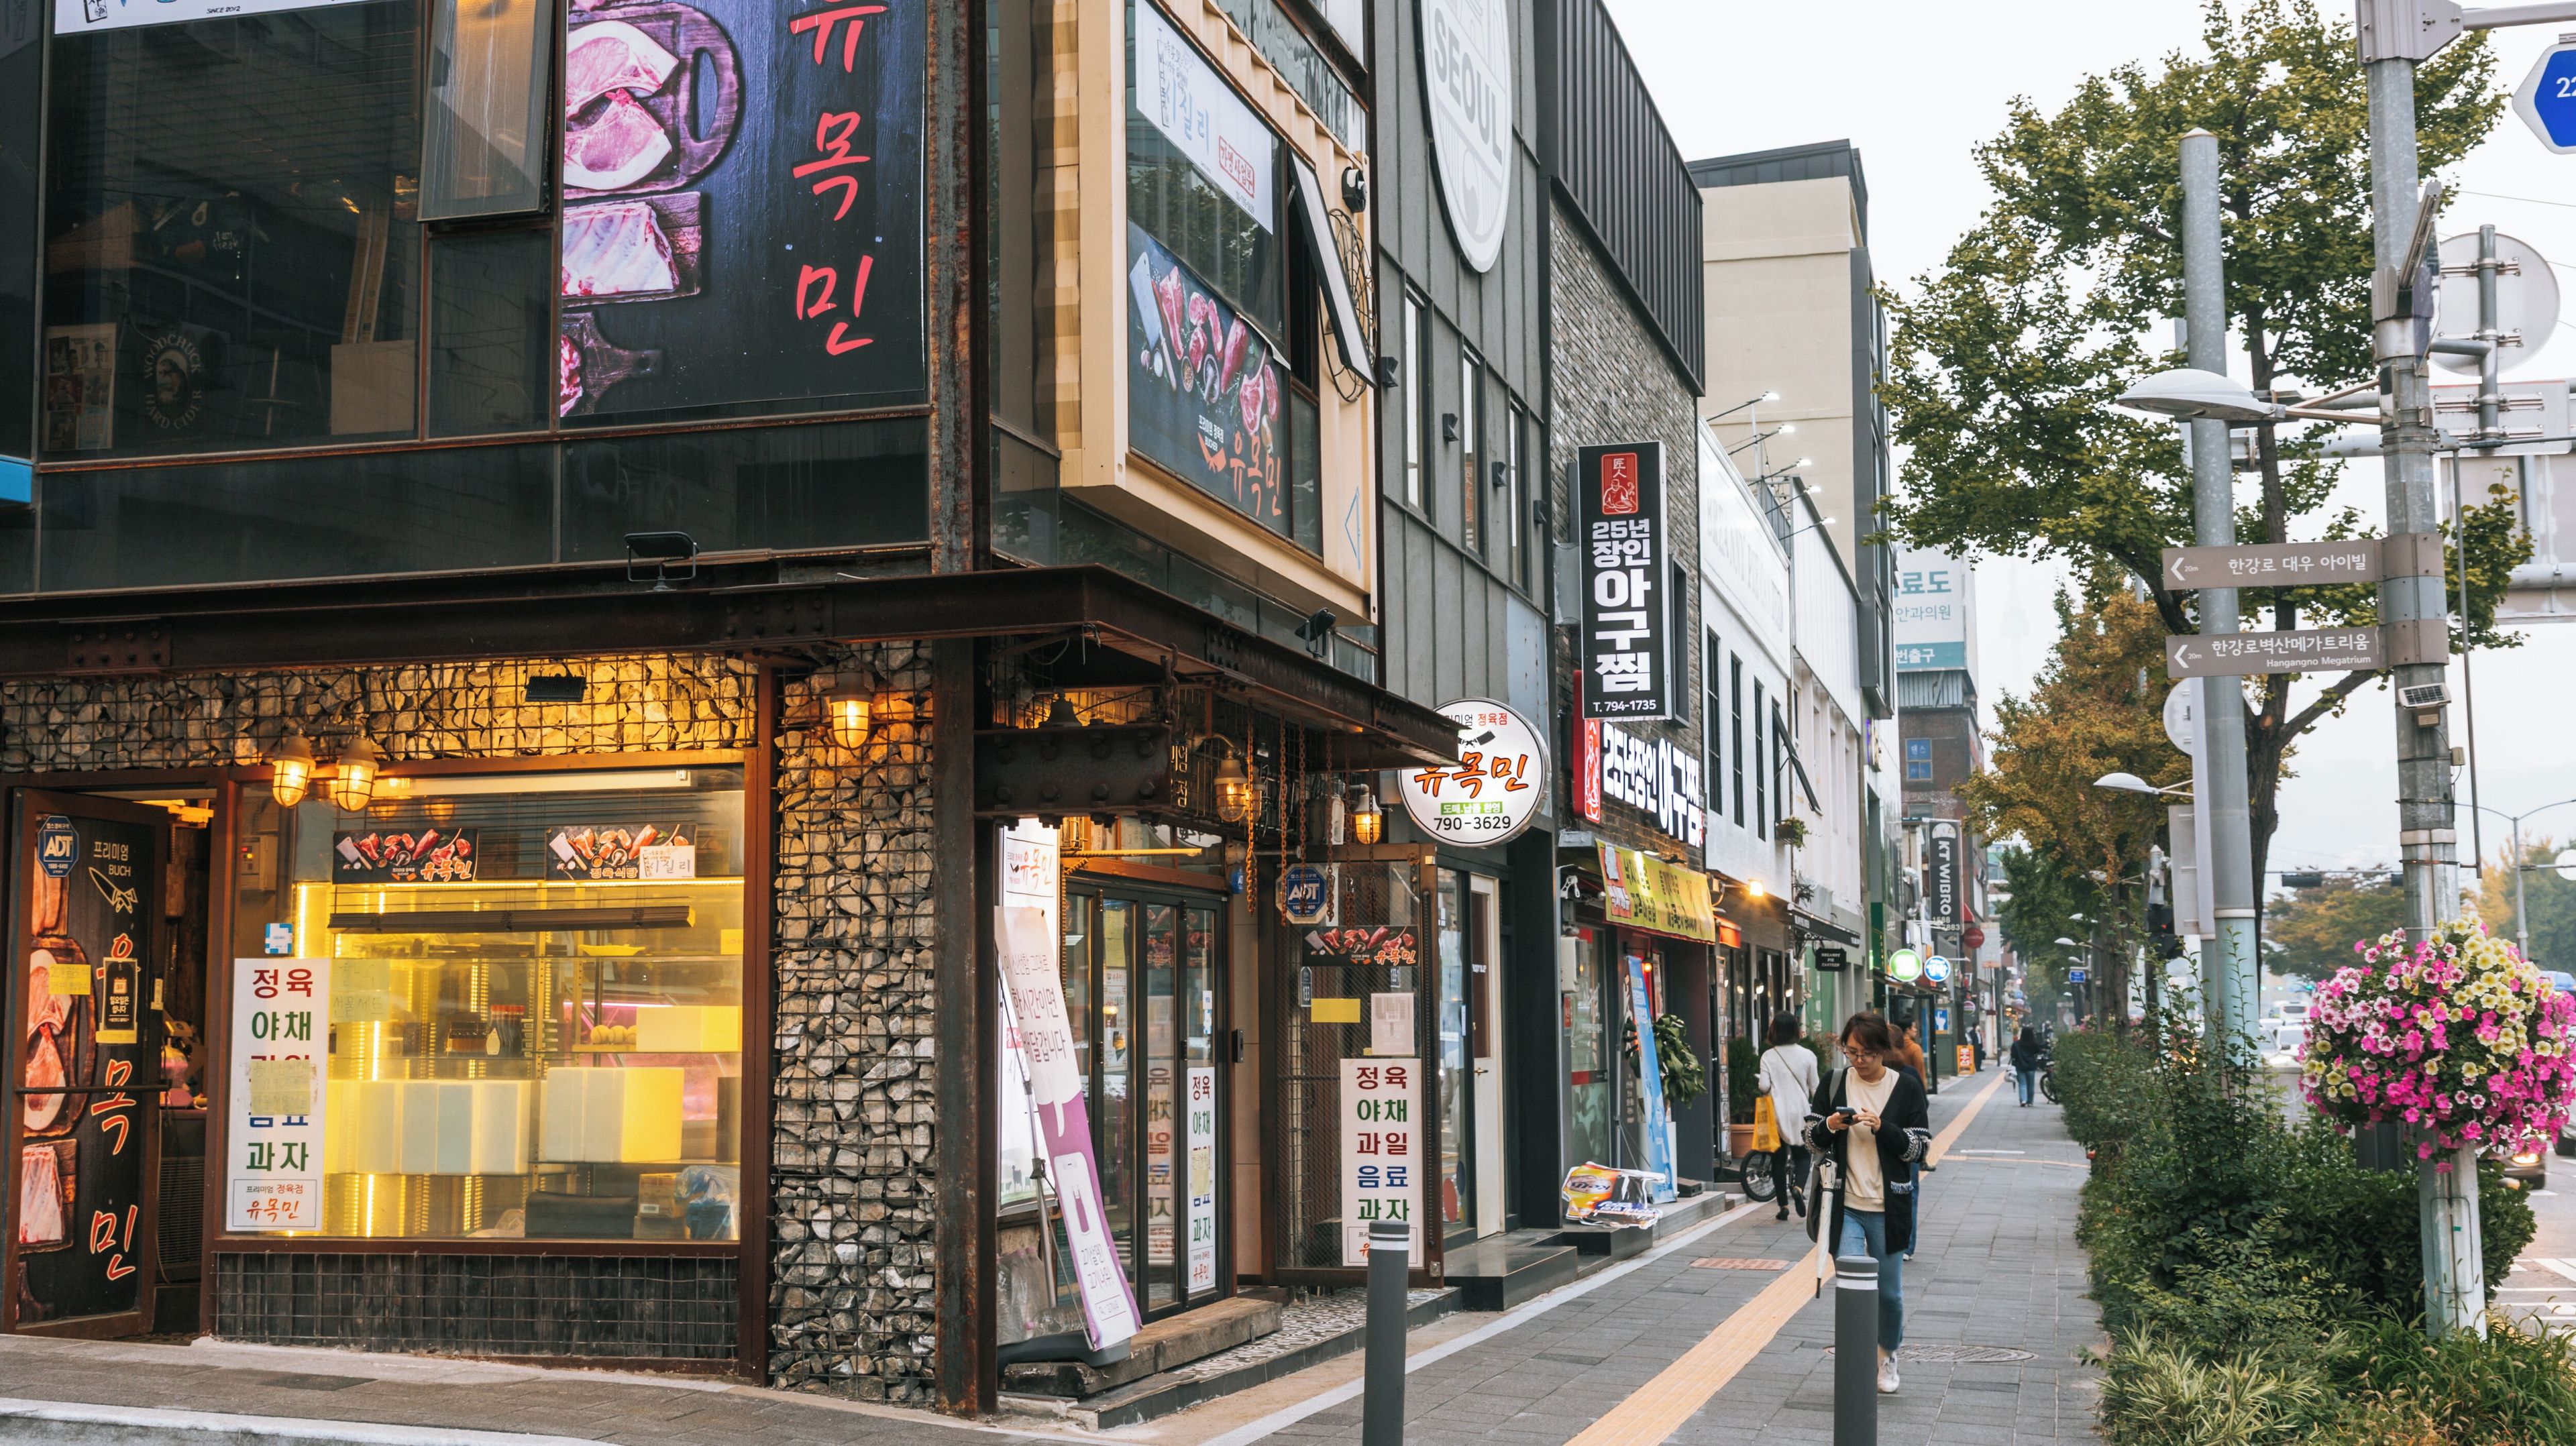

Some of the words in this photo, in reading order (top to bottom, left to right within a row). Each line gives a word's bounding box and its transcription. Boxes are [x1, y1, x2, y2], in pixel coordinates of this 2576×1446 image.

[1434, 7, 1503, 166] SEOUL
[144, 334, 201, 379] WOODCHUCK
[146, 394, 170, 429] HARD
[174, 390, 201, 429] CIDER
[1230, 431, 1282, 516] 유목민
[1613, 458, 1627, 478] 匠人
[1593, 518, 1650, 539] 25년
[1592, 539, 1650, 567] 장인
[2228, 558, 2277, 575] 한강로
[2282, 556, 2314, 572] 대우
[2320, 553, 2366, 571] 아이빌
[1896, 605, 1951, 622] 안과의원
[1594, 568, 1651, 692] 아구찜
[1896, 648, 1935, 663] 번출구
[2212, 634, 2369, 657] 한강로벽산메가트리움
[2267, 659, 2318, 668] Hangangno
[2321, 656, 2371, 666] Megatrium
[1593, 702, 1602, 712] T.
[1605, 699, 1656, 712] 794-1735
[1478, 713, 1507, 726] 정육점
[1414, 752, 1529, 799] 유목민
[1434, 816, 1511, 830] 790-3629
[44, 836, 73, 856] ADT
[93, 841, 129, 861] 프리미엄
[1938, 840, 1950, 860] KT
[109, 864, 131, 877] BUCH
[421, 859, 472, 882] 유목민
[590, 867, 638, 879] 정육식당
[1020, 848, 1052, 889] 유목민
[1288, 883, 1320, 901] ADT
[1939, 863, 1951, 915] WIBRO
[1374, 948, 1416, 965] 유목민
[253, 968, 313, 998] 정육
[1012, 987, 1059, 1019] 한시간이면
[252, 1011, 312, 1041] 야채
[1193, 1076, 1210, 1101] 정육
[1356, 1067, 1407, 1089] 정육
[1357, 1099, 1407, 1122] 야채
[1193, 1111, 1210, 1135] 야채
[1357, 1133, 1407, 1156] 과일
[246, 1142, 309, 1171] 과자
[1358, 1166, 1408, 1188] 음료
[276, 1184, 303, 1194] 정육점
[247, 1198, 299, 1222] 유목민
[1358, 1199, 1409, 1221] 과자
[1193, 1217, 1211, 1242] 과자
[1193, 1264, 1210, 1283] 유목민
